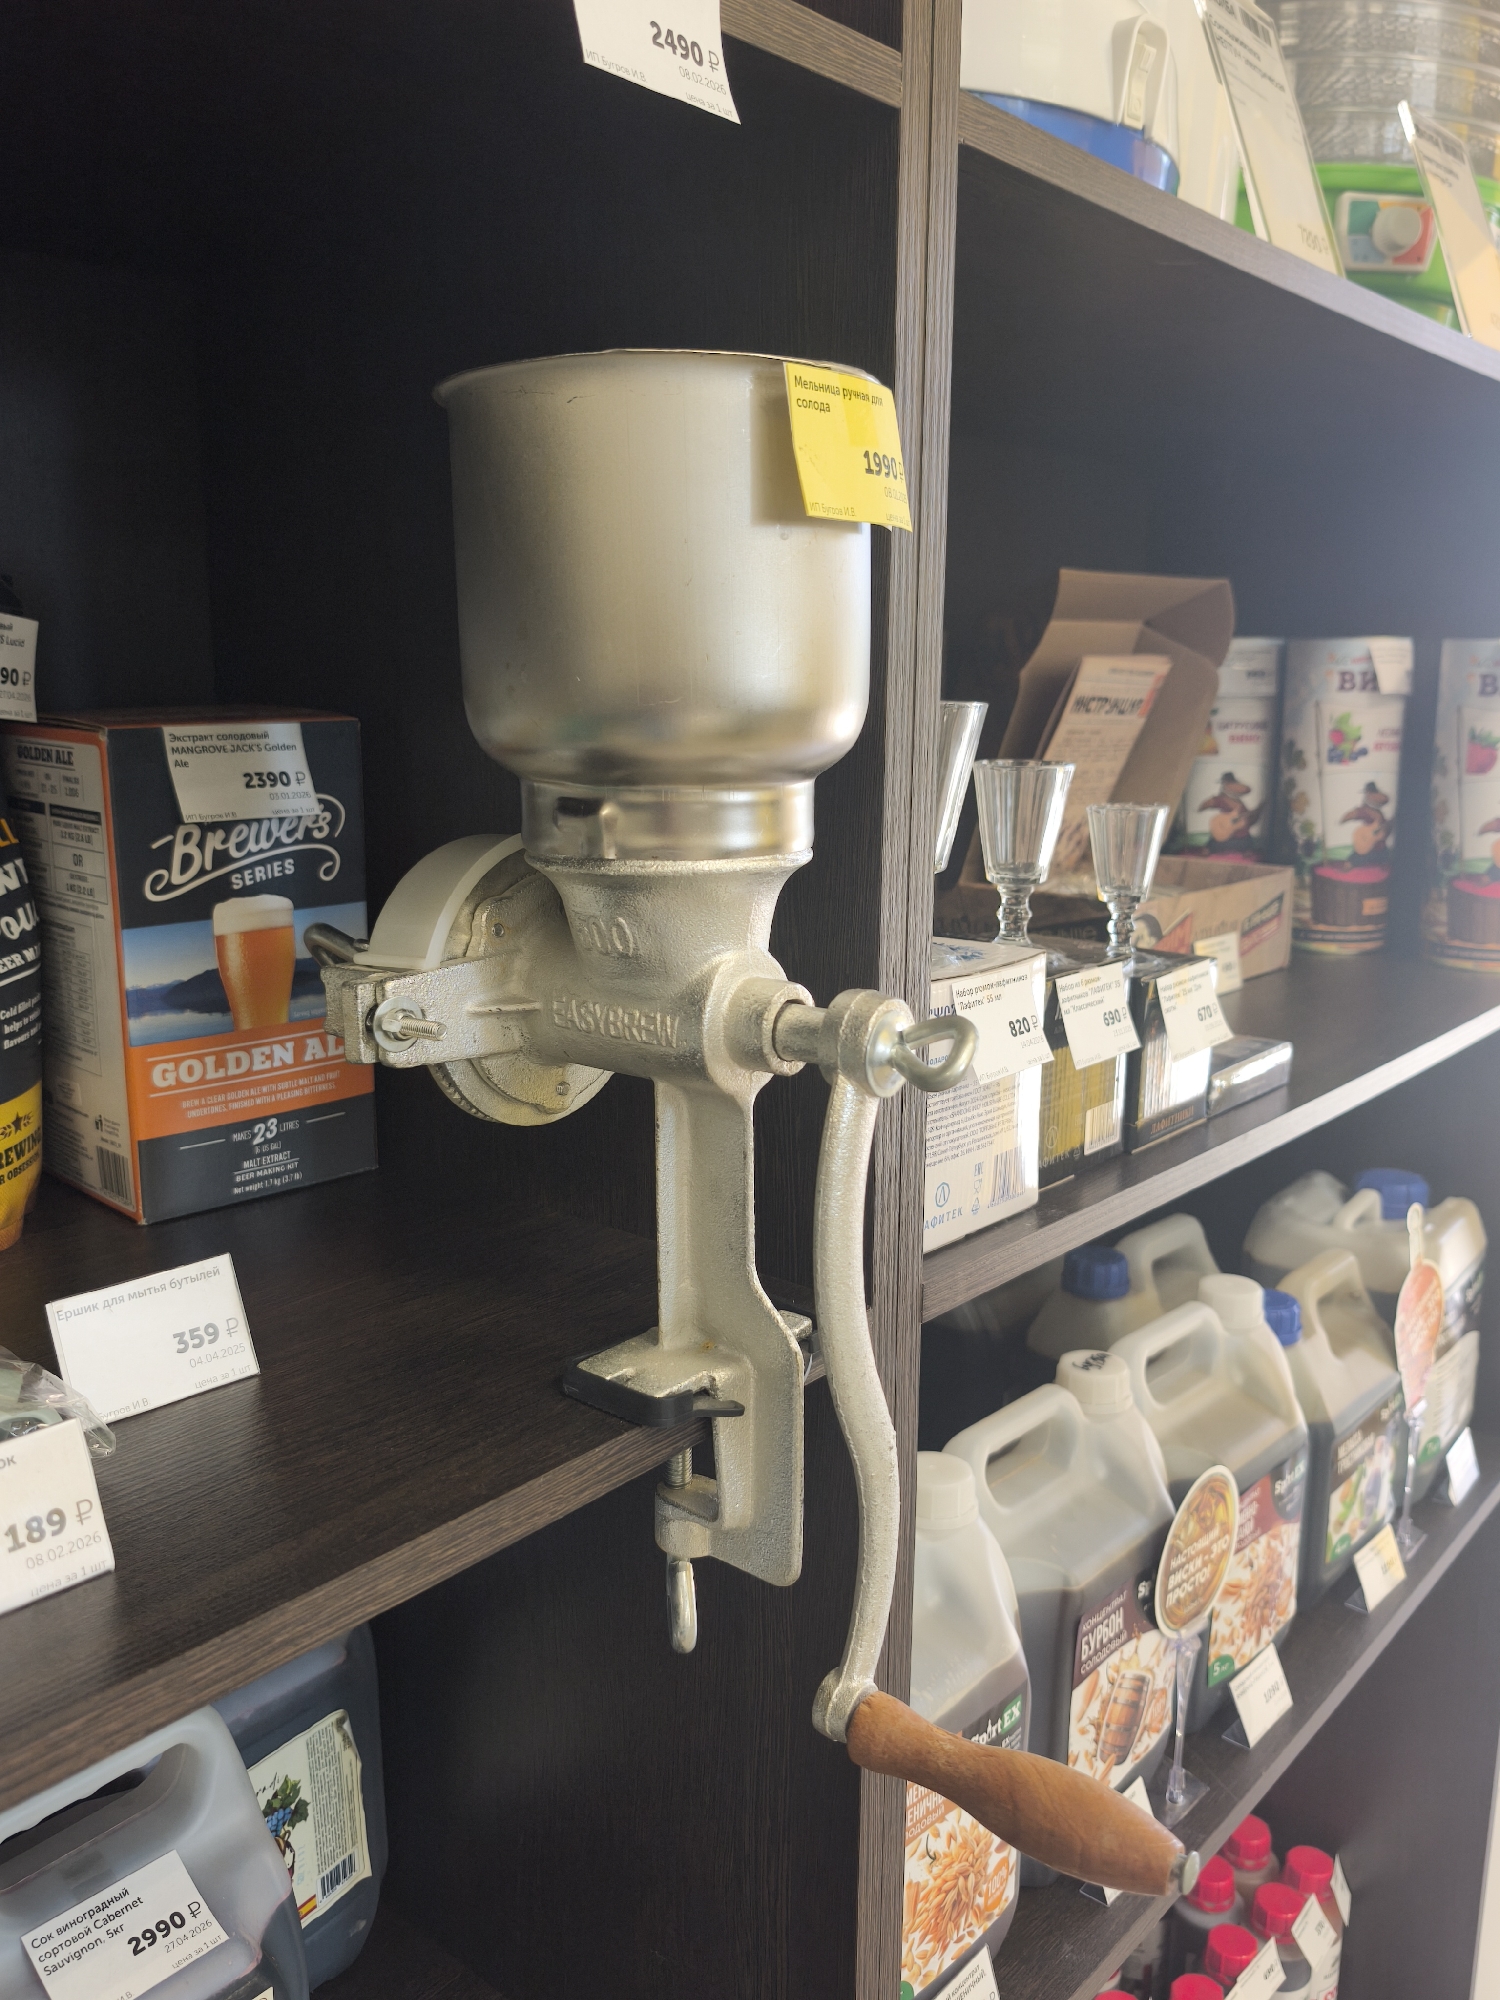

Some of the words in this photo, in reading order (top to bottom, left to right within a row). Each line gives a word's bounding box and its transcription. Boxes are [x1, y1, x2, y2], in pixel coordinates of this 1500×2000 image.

[650, 20, 703, 67] 2490
[585, 48, 600, 63] ИП
[601, 55, 630, 77] Бугров
[679, 65, 727, 95] 08.02.2026
[794, 375, 841, 397] Мельница
[842, 387, 870, 403] ручная
[871, 394, 884, 407] для
[796, 396, 831, 414] солода
[863, 450, 897, 480] 1990
[809, 501, 821, 511] ИП
[822, 501, 843, 516] Бугров
[169, 733, 214, 744] Экстракт
[217, 731, 270, 742] солодовый
[171, 745, 228, 755] MANGROVE
[230, 744, 263, 753] JACK'S
[265, 743, 297, 752] Golden
[17, 745, 53, 762] GOLDEN
[55, 752, 74, 766] ALE
[174, 760, 190, 768] Ale
[243, 771, 292, 789] 2390
[73, 853, 84, 867] OR
[231, 858, 295, 890] SERIES
[955, 987, 974, 998] Набор
[986, 994, 994, 1003] 55
[0, 1006, 18, 1020] Cold
[552, 998, 680, 1049] EASYBREW
[1009, 1017, 1031, 1037] 820
[1103, 1008, 1121, 1026] 690
[1197, 1005, 1212, 1021] 670
[4, 1021, 23, 1035] helps
[4, 1031, 30, 1050] flavours
[152, 1041, 294, 1088] GOLDEN
[304, 1035, 345, 1062] AL
[182, 1098, 200, 1108] BREW
[207, 1093, 226, 1104] CLEAR
[227, 1089, 250, 1100] GOLDEN
[250, 1086, 261, 1095] ALE
[261, 1083, 277, 1093] WITH
[277, 1080, 298, 1090] SUBTLE
[298, 1075, 313, 1085] MALT
[314, 1073, 325, 1083] AND
[326, 1070, 340, 1080] FRUIT
[228, 1098, 255, 1110] FINISHED
[255, 1095, 271, 1105] WITH
[276, 1089, 303, 1100] PLEASING
[232, 1130, 252, 1142] MAKES
[252, 1117, 278, 1146] 23
[280, 1120, 300, 1132] LITRES
[236, 1172, 255, 1182] BEER
[256, 1164, 286, 1178] MAKING
[287, 1162, 299, 1170] KIT
[243, 1157, 261, 1169] MALT
[262, 1150, 291, 1165] EXTRACT
[234, 1186, 244, 1195] Net
[245, 1182, 264, 1192] weight
[56, 1299, 99, 1323] Ершик
[102, 1293, 125, 1310] для
[127, 1280, 167, 1303] мытья
[168, 1266, 221, 1290] бутылей
[172, 1322, 220, 1354] 359
[189, 1343, 246, 1369] 04.04.2025
[194, 1374, 219, 1390] цена
[219, 1372, 231, 1382] за
[231, 1366, 238, 1379] 1
[239, 1365, 251, 1376] шт
[132, 1397, 151, 1411] И.В.
[4, 1507, 67, 1553] 189
[26, 1531, 102, 1570] 08.02.2026
[1170, 1522, 1220, 1571] НАСТОЯЩИЙ
[1168, 1554, 1202, 1591] ВИСКИ
[1210, 1534, 1230, 1558] ЭТО
[30, 1577, 62, 1598] цена
[64, 1572, 78, 1582] за
[81, 1566, 87, 1577] 1
[89, 1560, 108, 1574] шт
[1166, 1562, 1212, 1609] ПРОСТО!
[1081, 1589, 1128, 1633] КОНЦЕНТРАТ
[1081, 1606, 1125, 1661] БУРБОН
[1080, 1630, 1128, 1675] СОЛОДОВЫЙ
[31, 1931, 54, 1950] Сок
[57, 1887, 130, 1935] виноградный
[38, 1926, 92, 1963] сортовой
[93, 1896, 144, 1930] Cabernet
[127, 1911, 186, 1956] 2990
[164, 1919, 213, 1953] 27.04.2026
[43, 1938, 106, 1977] Sauvignon,
[106, 1923, 125, 1939] 5кг
[171, 1955, 193, 1970] цена
[194, 1947, 204, 1957] за
[211, 1935, 222, 1947] шт
